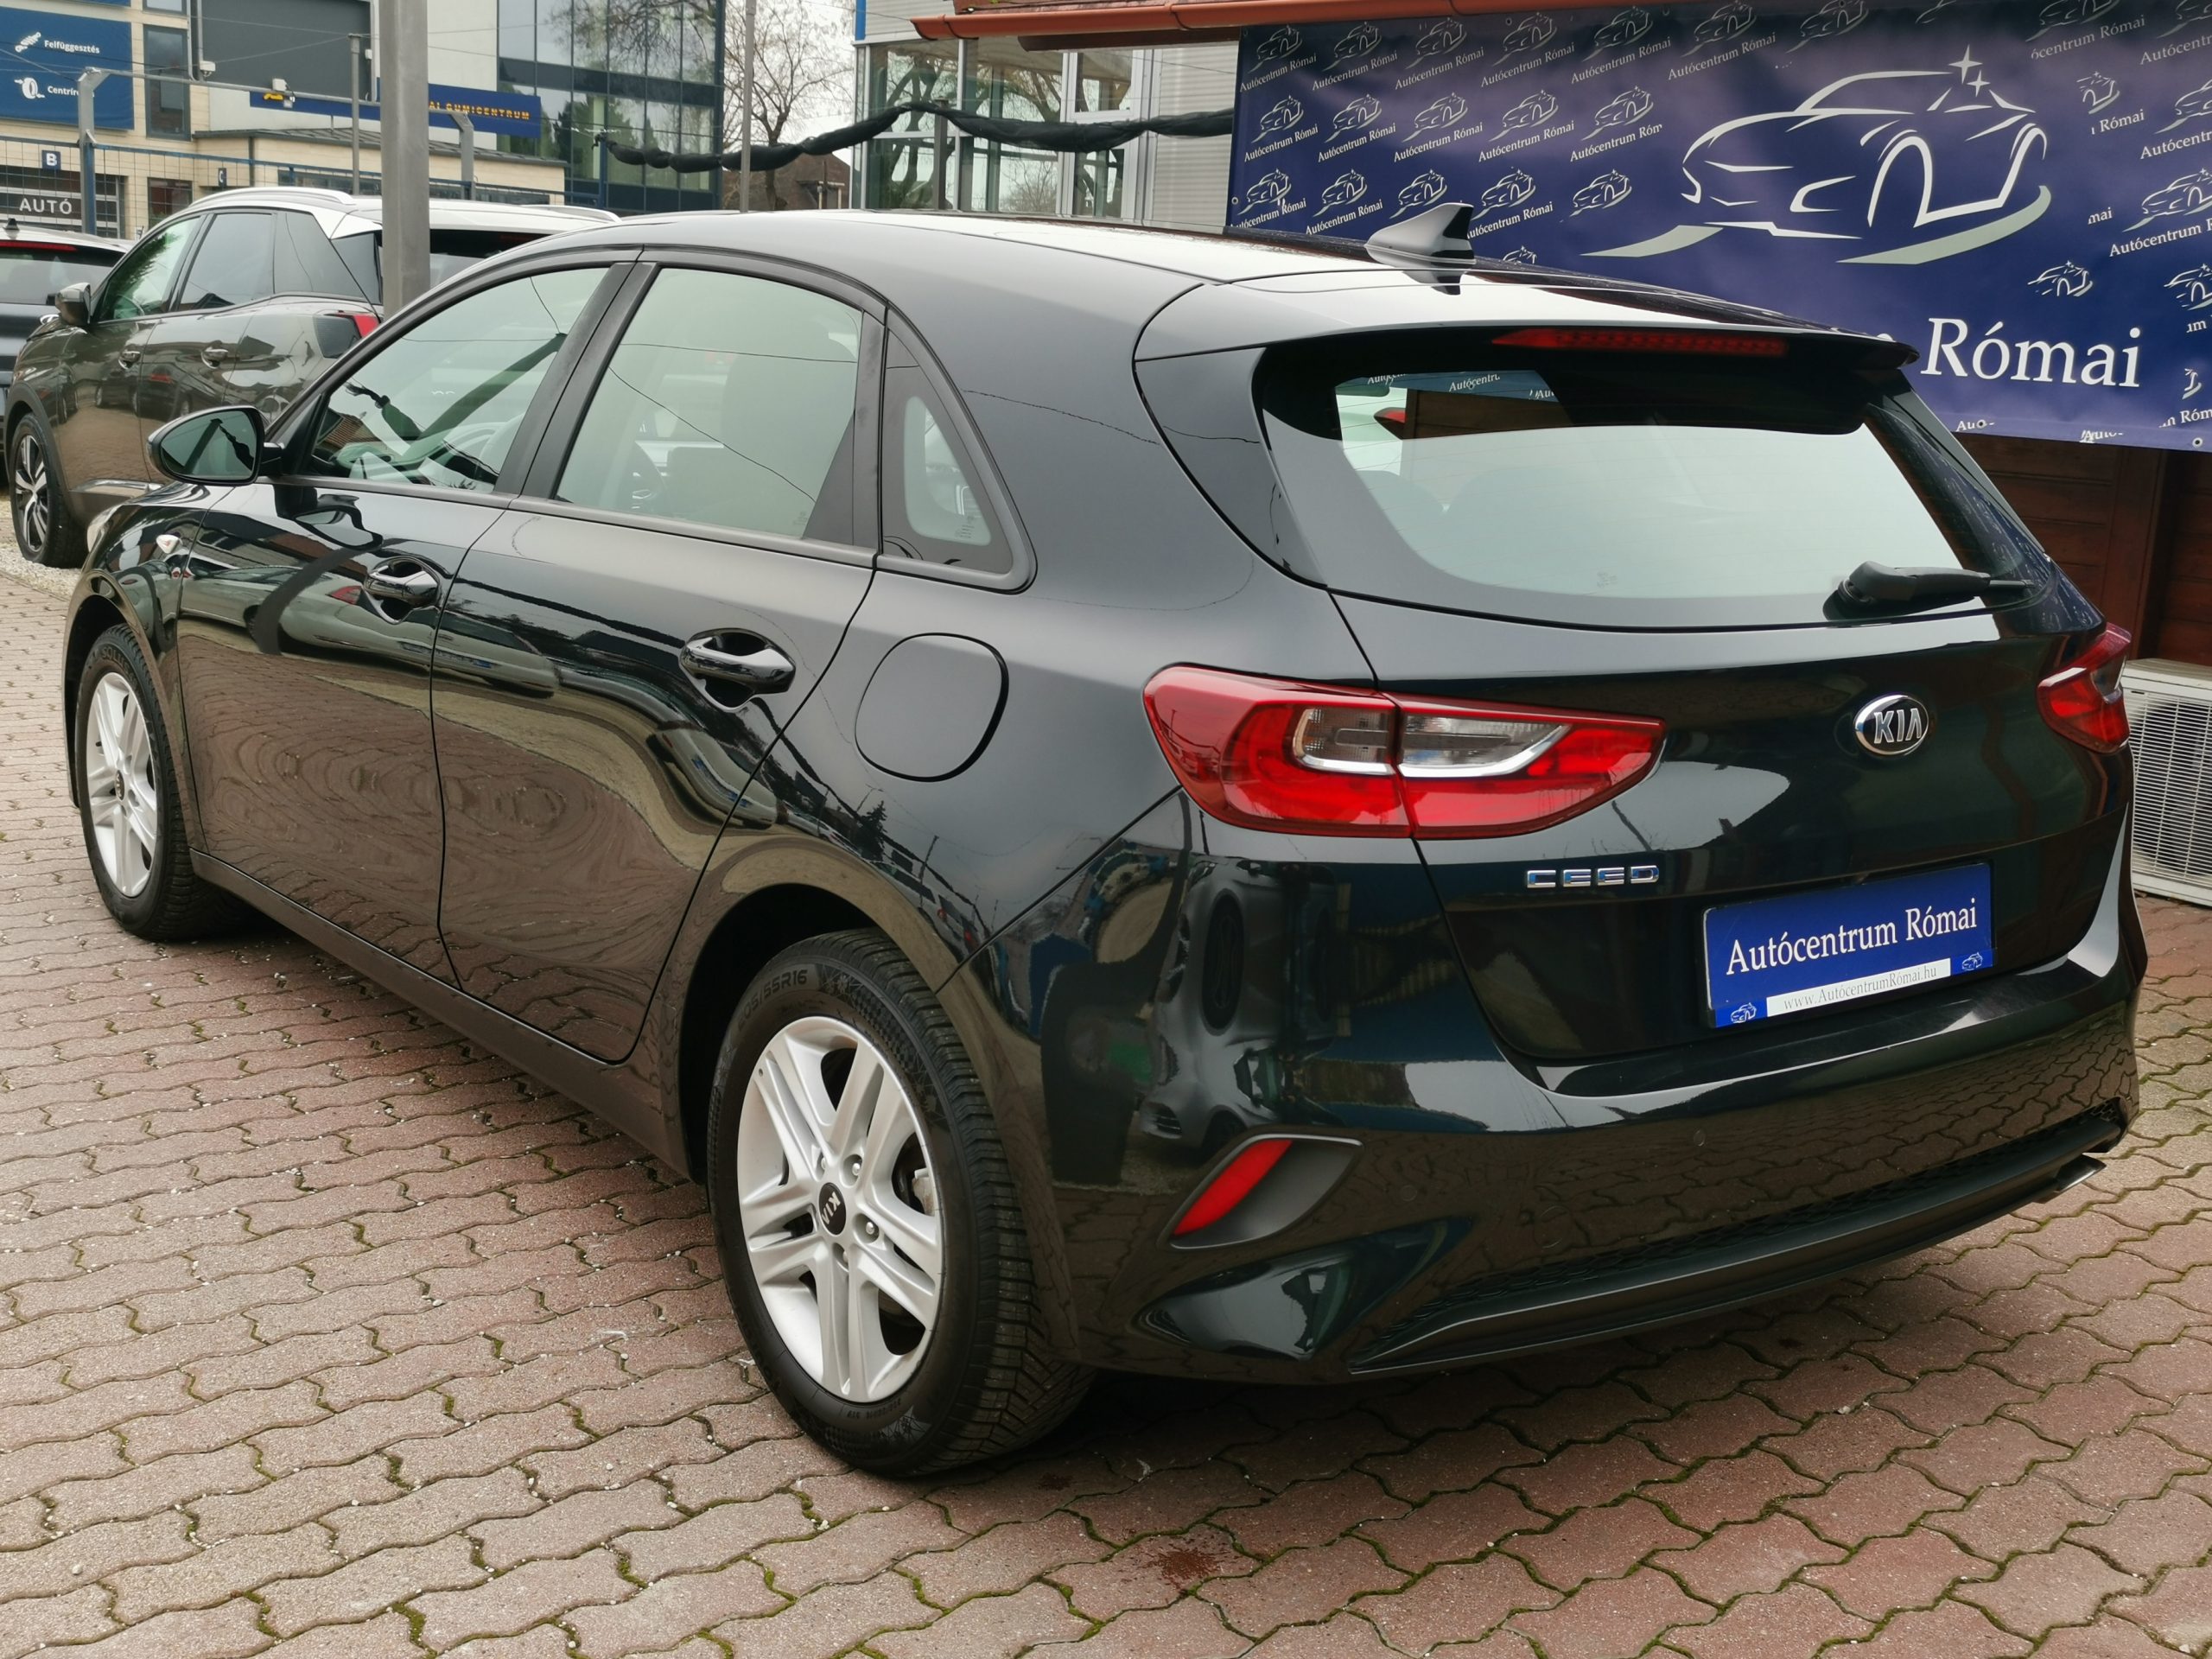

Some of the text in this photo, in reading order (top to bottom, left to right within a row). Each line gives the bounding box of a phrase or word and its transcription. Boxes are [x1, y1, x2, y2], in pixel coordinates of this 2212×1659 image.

[2100, 15, 2145, 39] Római
[44, 40, 100, 54] Felfüggesztés
[1481, 42, 1575, 87] Autócentrum Római
[1571, 36, 1671, 84] Autócentrum Római
[1668, 32, 1777, 80] Autócentrum Római
[1240, 53, 1317, 92] Autócentrum Római
[1313, 50, 1398, 91] Autócentrum Római
[1395, 48, 1484, 90] Autócentrum Római
[48, 86, 94, 97] Centrír
[446, 103, 531, 120] GUMICENTRUM
[2099, 109, 2145, 132] Római
[1244, 124, 1319, 162] Autócentrum Római
[1318, 123, 1396, 162] Autócentrum Római
[1394, 122, 1484, 162] Autócentrum Római
[1478, 120, 1574, 162] Autócentrum Római
[1570, 132, 1637, 162] Autócentrum
[46, 153, 57, 167] B
[19, 197, 73, 214] AUTÓ
[1281, 198, 1306, 215] Római
[1306, 199, 1383, 235] Autócentrum Római
[1522, 201, 1554, 219] Római
[2109, 225, 2202, 257] Autócentrum
[1920, 317, 2140, 387] Római
[1873, 707, 1923, 745] KIA
[1526, 865, 1660, 888] CEED
[1726, 898, 1977, 975] Autócentrum Római
[1783, 965, 1937, 1010] www.AutócentrumRómai.hu
[821, 1191, 842, 1225] KIA
